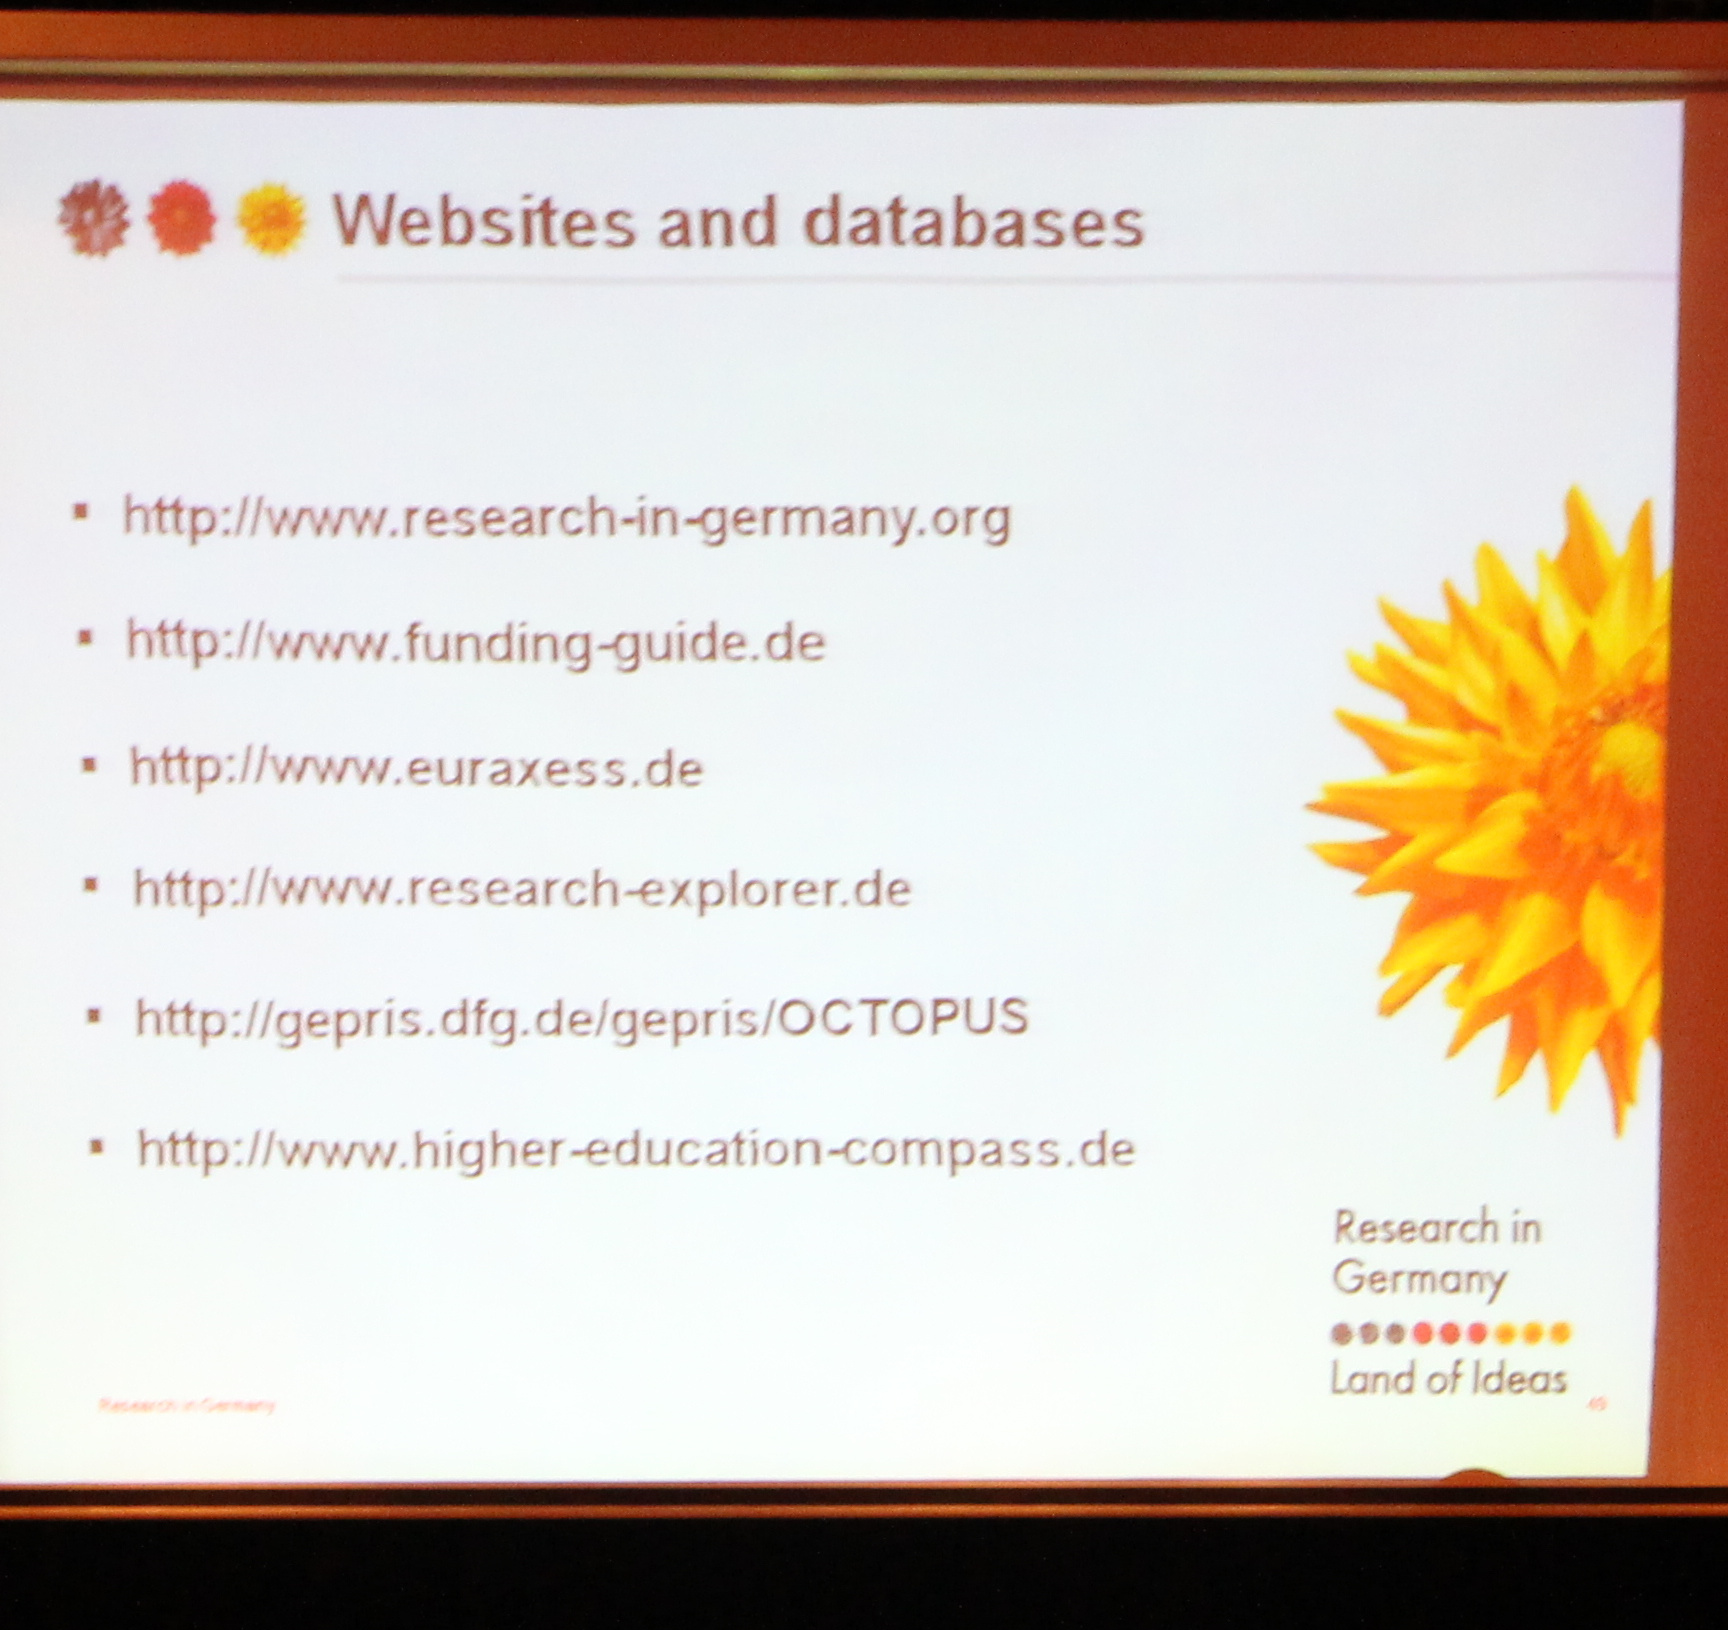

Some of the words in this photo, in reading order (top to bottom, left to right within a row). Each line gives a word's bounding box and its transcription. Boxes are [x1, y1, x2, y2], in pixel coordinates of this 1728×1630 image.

[332, 192, 638, 250] Websites
[658, 193, 779, 250] and
[802, 192, 1146, 249] databases
[125, 493, 1013, 549] http://www.research-in-germany.org
[128, 617, 827, 675] http://www.funding-guide.de
[130, 744, 706, 797] http://www.euraxess.de
[135, 866, 913, 919] http://www.research-explorer.de
[137, 996, 1031, 1051] http://gepris.dfg.de/gepris/OCTOPUS
[138, 1128, 1138, 1180] http://www.higher-education-compass.de
[1334, 1204, 1500, 1245] Research
[1511, 1208, 1543, 1244] in
[1332, 1257, 1510, 1306] Germany
[1331, 1359, 1417, 1396] Land
[1426, 1357, 1465, 1396] of
[1472, 1359, 1569, 1396] Ideas
